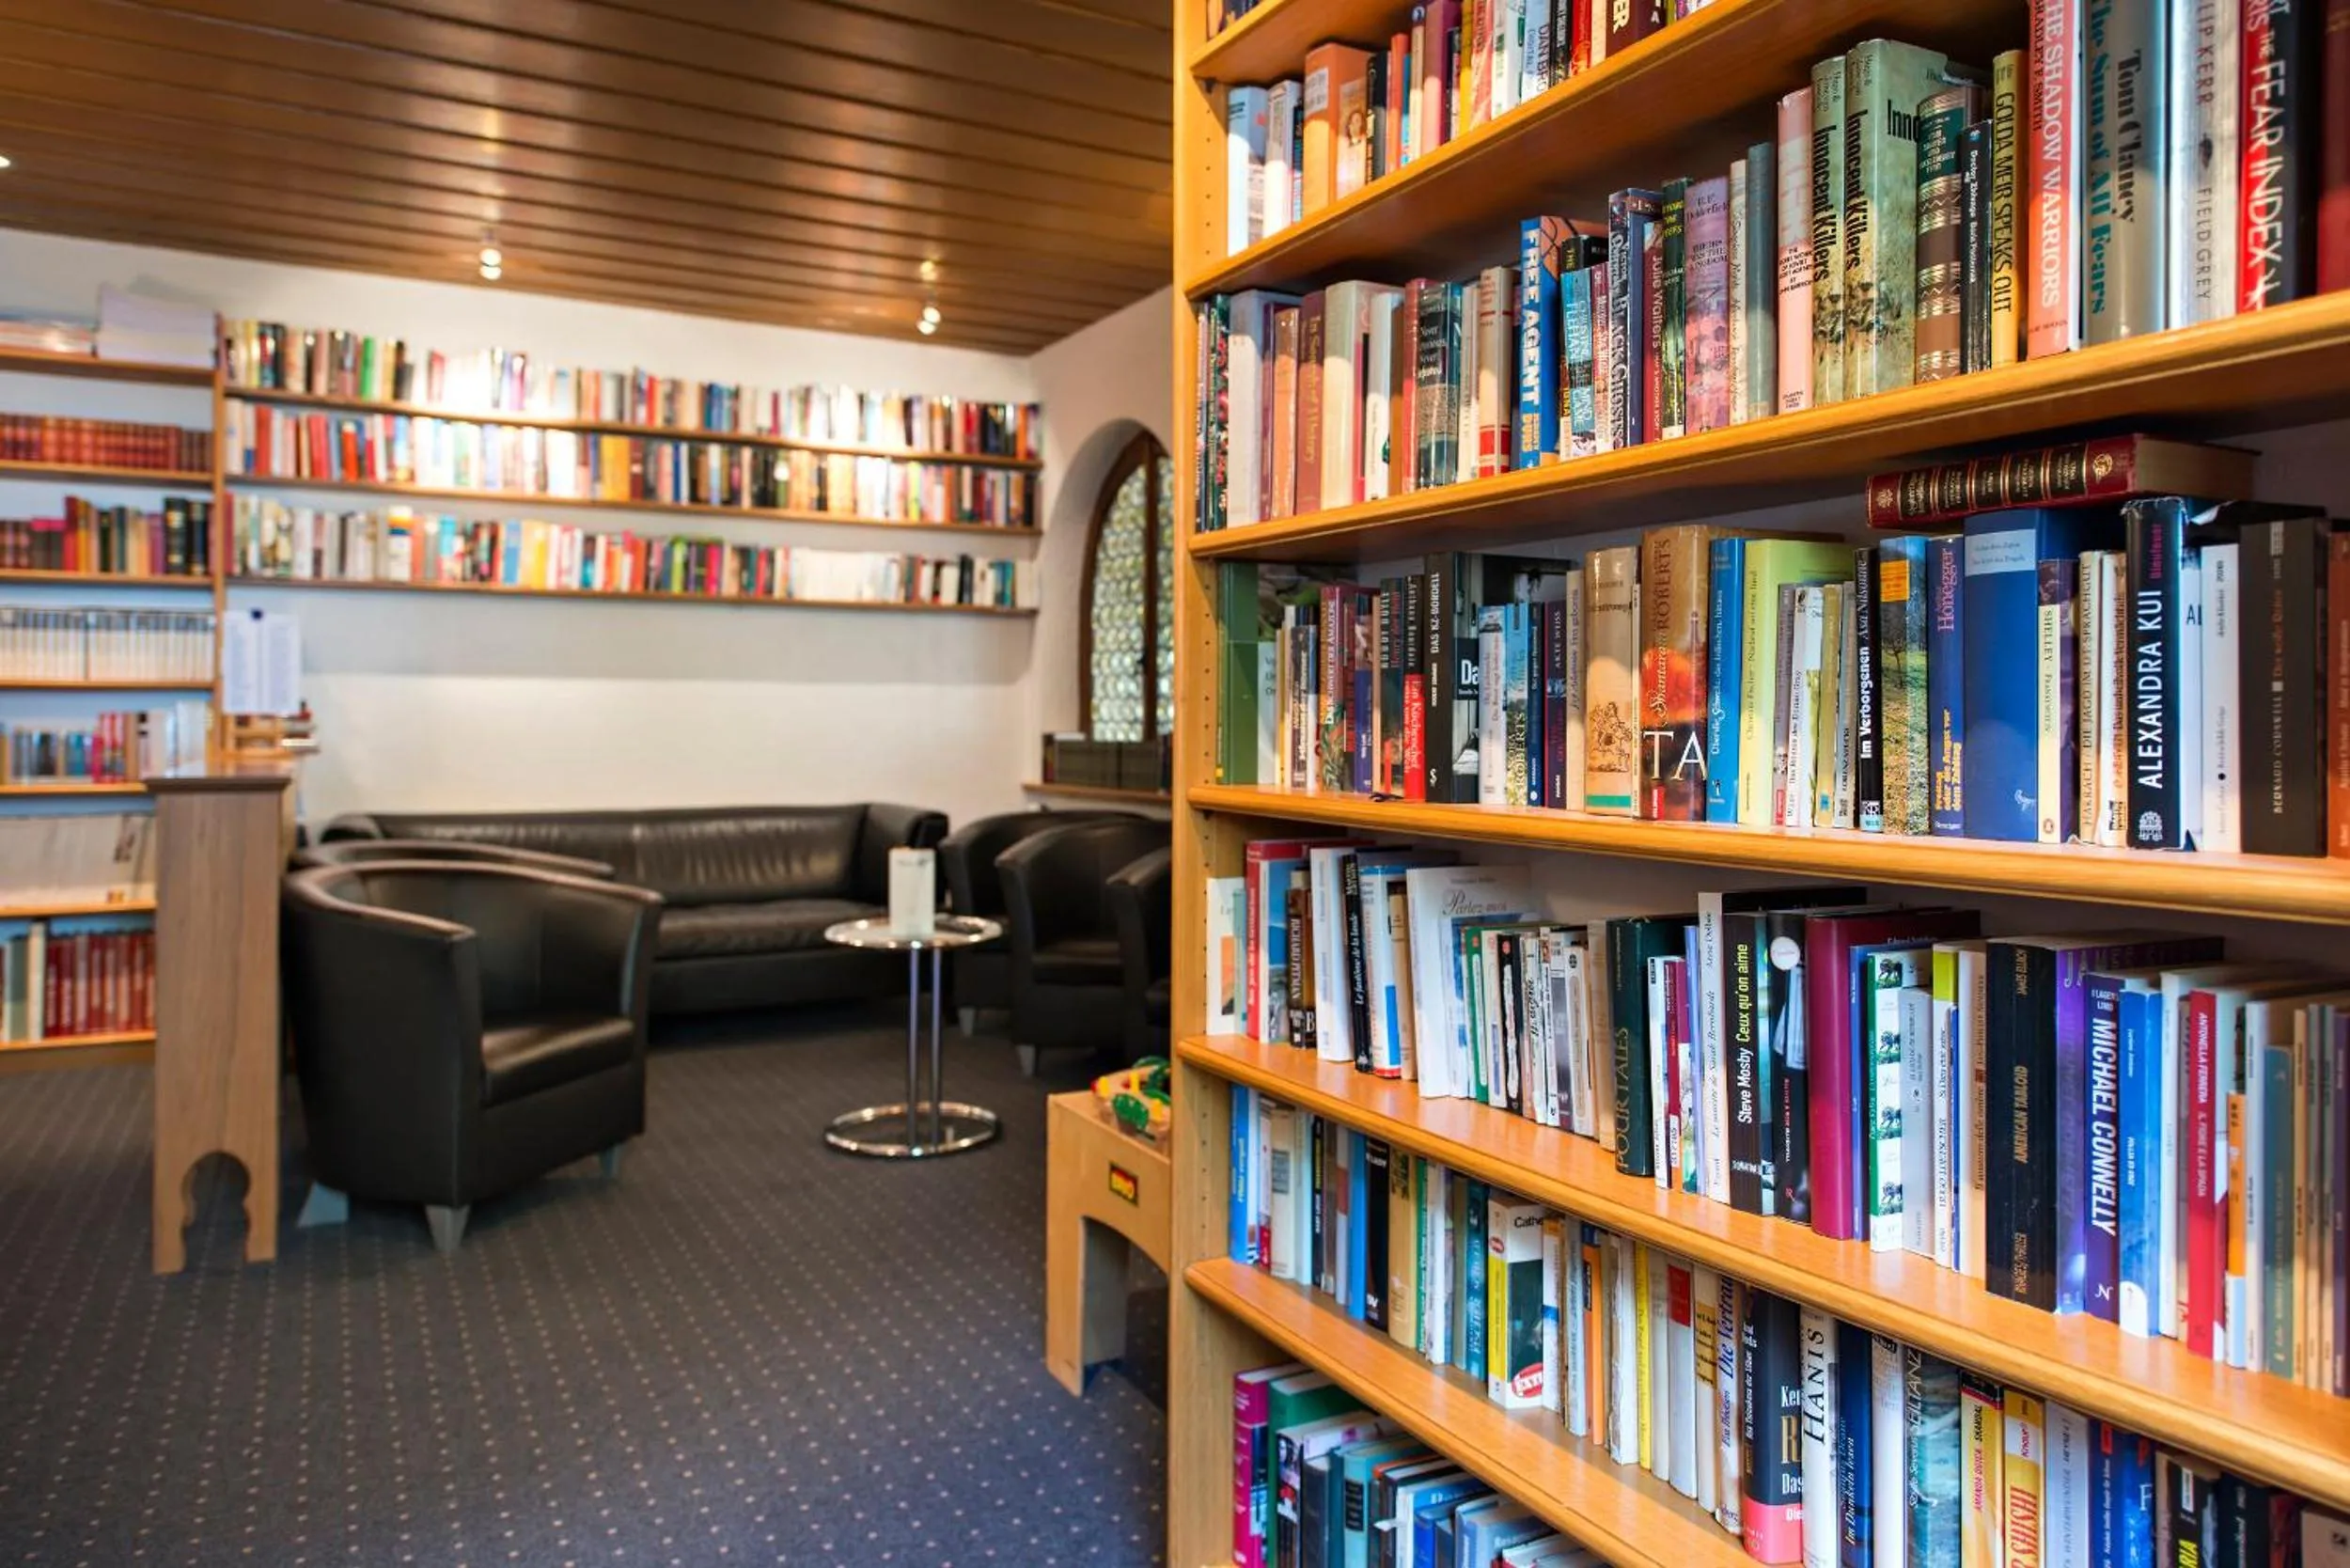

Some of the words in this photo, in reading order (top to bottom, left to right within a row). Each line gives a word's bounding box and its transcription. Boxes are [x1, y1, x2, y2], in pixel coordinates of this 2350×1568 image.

[2258, 28, 2276, 59] THE
[2092, 53, 2109, 127] Sum
[2118, 50, 2140, 118] Tom
[2195, 44, 2215, 106] KERR
[1995, 92, 2015, 154] GOLDA
[2031, 82, 2043, 133] SMITH
[2043, 44, 2065, 162] SHADOW
[2248, 58, 2286, 154] FEAR
[1813, 125, 1838, 217] Innocent
[1844, 109, 1869, 200] Innocent
[1969, 149, 1978, 180] Doctor
[2092, 130, 2111, 162] of
[2111, 120, 2140, 223] Clancy
[1968, 181, 1978, 218] Zhivago
[1994, 156, 2014, 202] MEIR
[2091, 172, 2111, 215] All
[1845, 199, 1869, 273] Killers
[2042, 165, 2062, 308] WARRIORS
[2196, 187, 2212, 243] FIELD
[2246, 155, 2284, 267] INDEX
[1813, 213, 1838, 284] Killers
[1993, 202, 2013, 274] SPEAKS
[1522, 228, 1542, 304] FREE
[1653, 254, 1663, 289] Julie
[2091, 223, 2111, 315] Fears
[2196, 248, 2213, 300] GREY
[1653, 291, 1664, 349] Walters
[1993, 276, 2013, 313] OUT
[1522, 309, 1542, 406] AGENT
[1654, 538, 1671, 633] ROBERTS
[1936, 548, 1958, 631] Honegger
[2138, 589, 2163, 630] KUI
[1431, 634, 1439, 654] DAS
[1553, 610, 1561, 640] WEISS
[2044, 609, 2054, 663] SHELLEY
[1553, 642, 1561, 669] AKTE
[1792, 669, 1802, 690] Gray
[1858, 646, 1872, 737] Verborgenen
[2082, 689, 2092, 725] JAGD
[2138, 641, 2163, 790] ALEXANDRA
[1514, 713, 1526, 786] ROBERTS
[1860, 739, 1872, 760] Im
[2082, 726, 2092, 749] DIE
[1943, 784, 1951, 811] oder
[1952, 786, 1962, 813] dem
[1290, 917, 1304, 961] RICHARD
[1733, 943, 1749, 974] aime
[1735, 977, 1753, 1011] qu'on
[1735, 1012, 1751, 1043] Ceux
[2198, 1012, 2209, 1064] ANTONELLA
[1735, 1048, 1754, 1088] Mosby
[2013, 1064, 2029, 1108] TABLOID
[2092, 1017, 2117, 1116] MICHAEL
[1736, 1090, 1753, 1124] Steve
[2013, 1110, 2029, 1164] AMERICAN
[2197, 1121, 2206, 1147] FIORE
[2091, 1121, 2117, 1237] CONNELLY
[2197, 1168, 2206, 1197] SPADA
[1717, 1341, 1734, 1380] Die
[1973, 1405, 1983, 1443] SKANDAL
[1844, 1436, 1856, 1470] lesen
[1845, 1472, 1856, 1526] Dunkeln
[2009, 1485, 2038, 1556] SHISHI
[1845, 1529, 1856, 1546] Im
